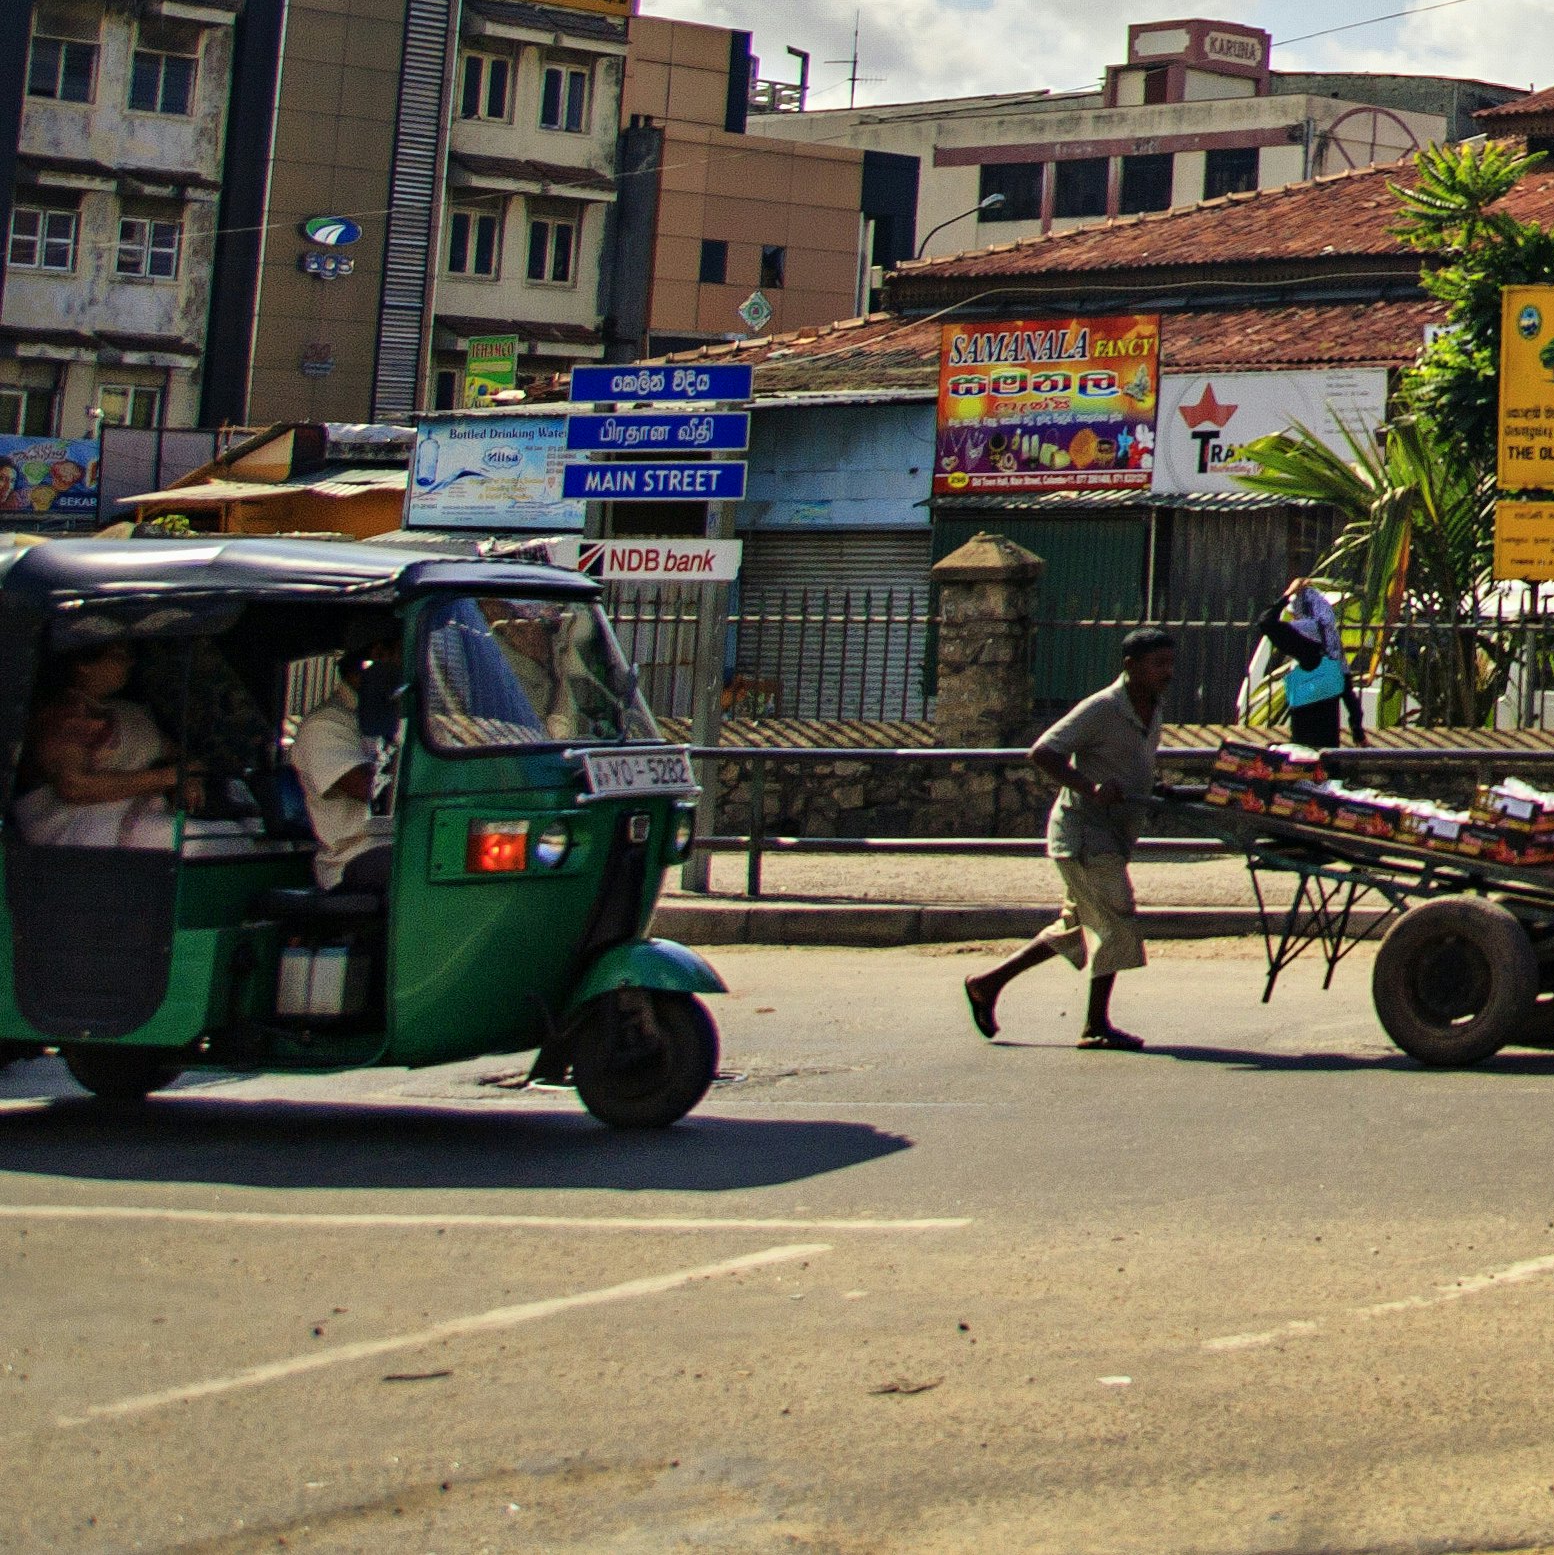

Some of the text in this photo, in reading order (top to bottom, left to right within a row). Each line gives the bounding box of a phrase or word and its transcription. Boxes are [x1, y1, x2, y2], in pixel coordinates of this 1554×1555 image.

[949, 327, 1155, 366] SAMANALA FANCY
[449, 428, 487, 439] Bottled
[489, 428, 535, 441] Drinking
[600, 417, 714, 446] பிரதான வீதி
[1507, 446, 1534, 460] THE
[585, 469, 722, 492] MAIN STREET
[609, 548, 716, 572] NDB bank
